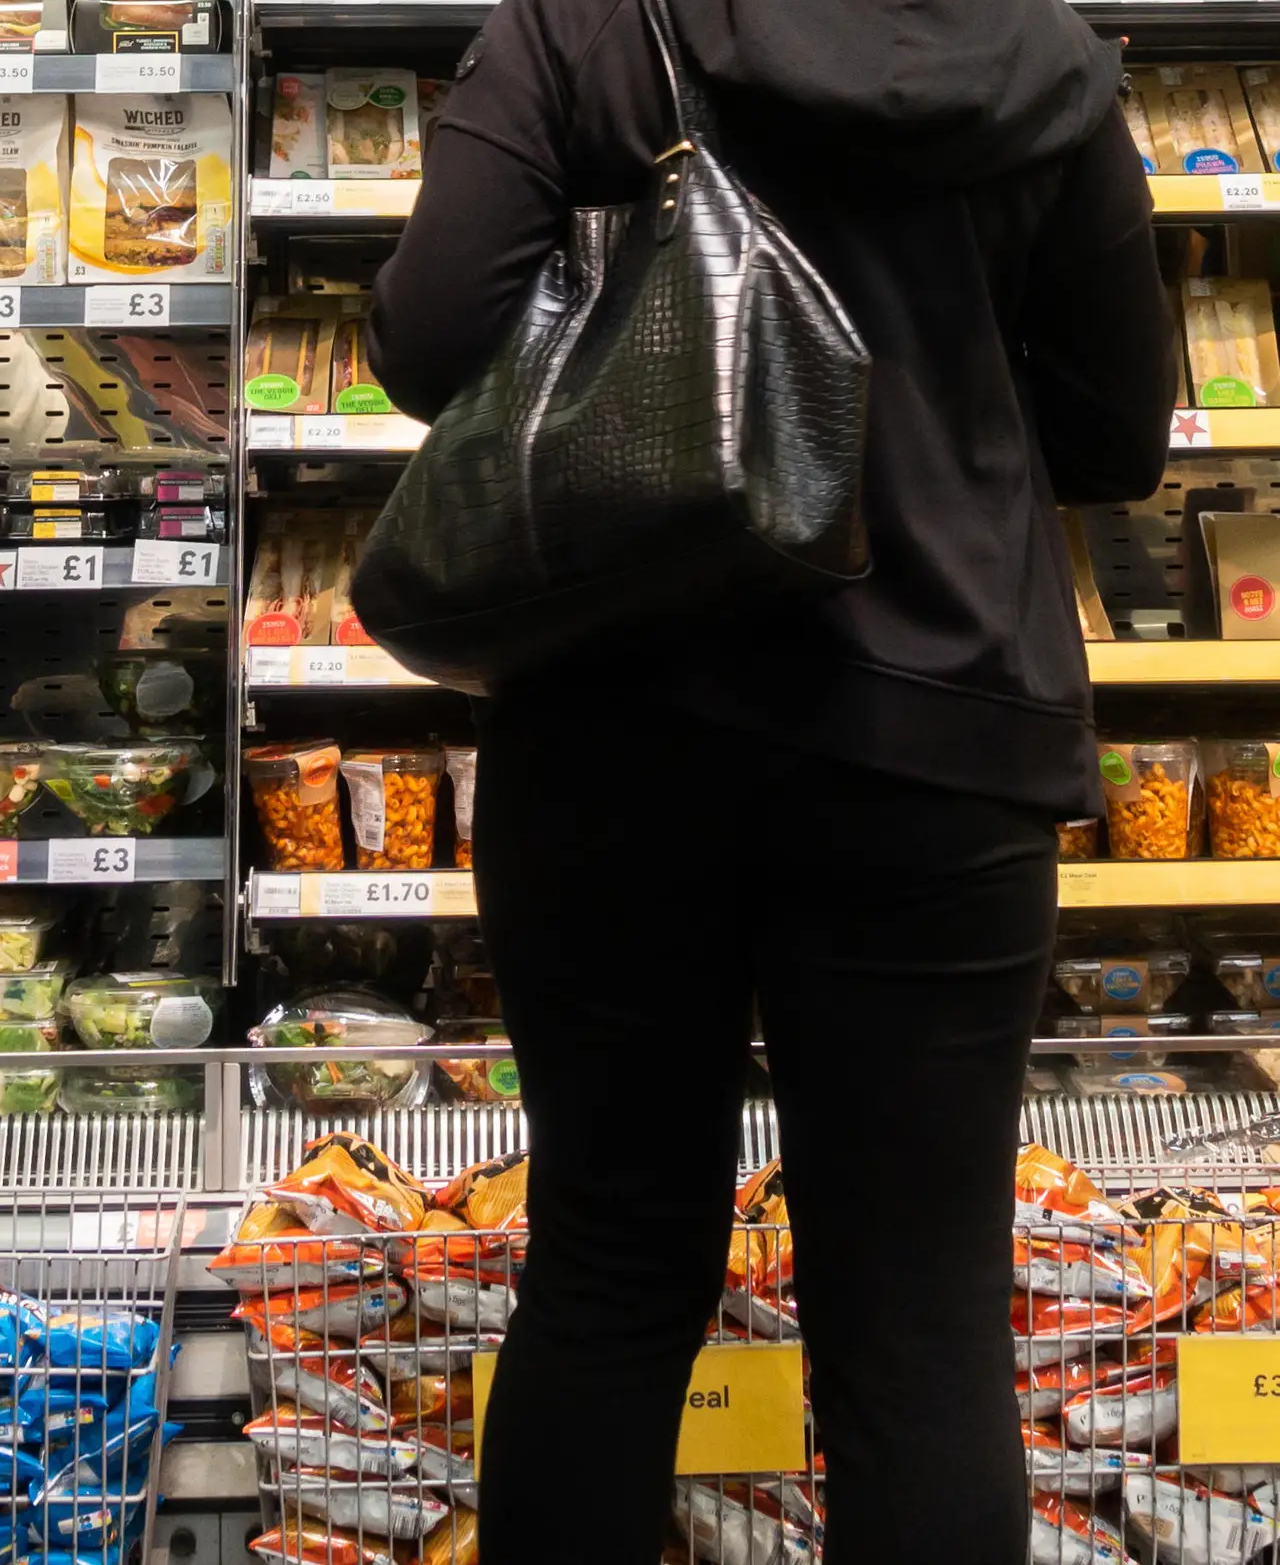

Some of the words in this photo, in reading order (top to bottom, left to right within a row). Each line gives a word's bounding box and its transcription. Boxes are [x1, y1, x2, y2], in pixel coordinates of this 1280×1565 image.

[138, 66, 176, 78] £3.50
[123, 109, 184, 125] WICKED
[1, 148, 19, 156] SLAW
[297, 193, 330, 203] £2.50
[1226, 187, 1259, 197] £2.20
[129, 293, 164, 316] £3
[64, 555, 97, 581] £1
[179, 551, 213, 578] £1
[309, 661, 342, 671] £2.20
[93, 848, 129, 872] £3
[366, 883, 429, 902] £1.70
[687, 1385, 730, 1409] eal
